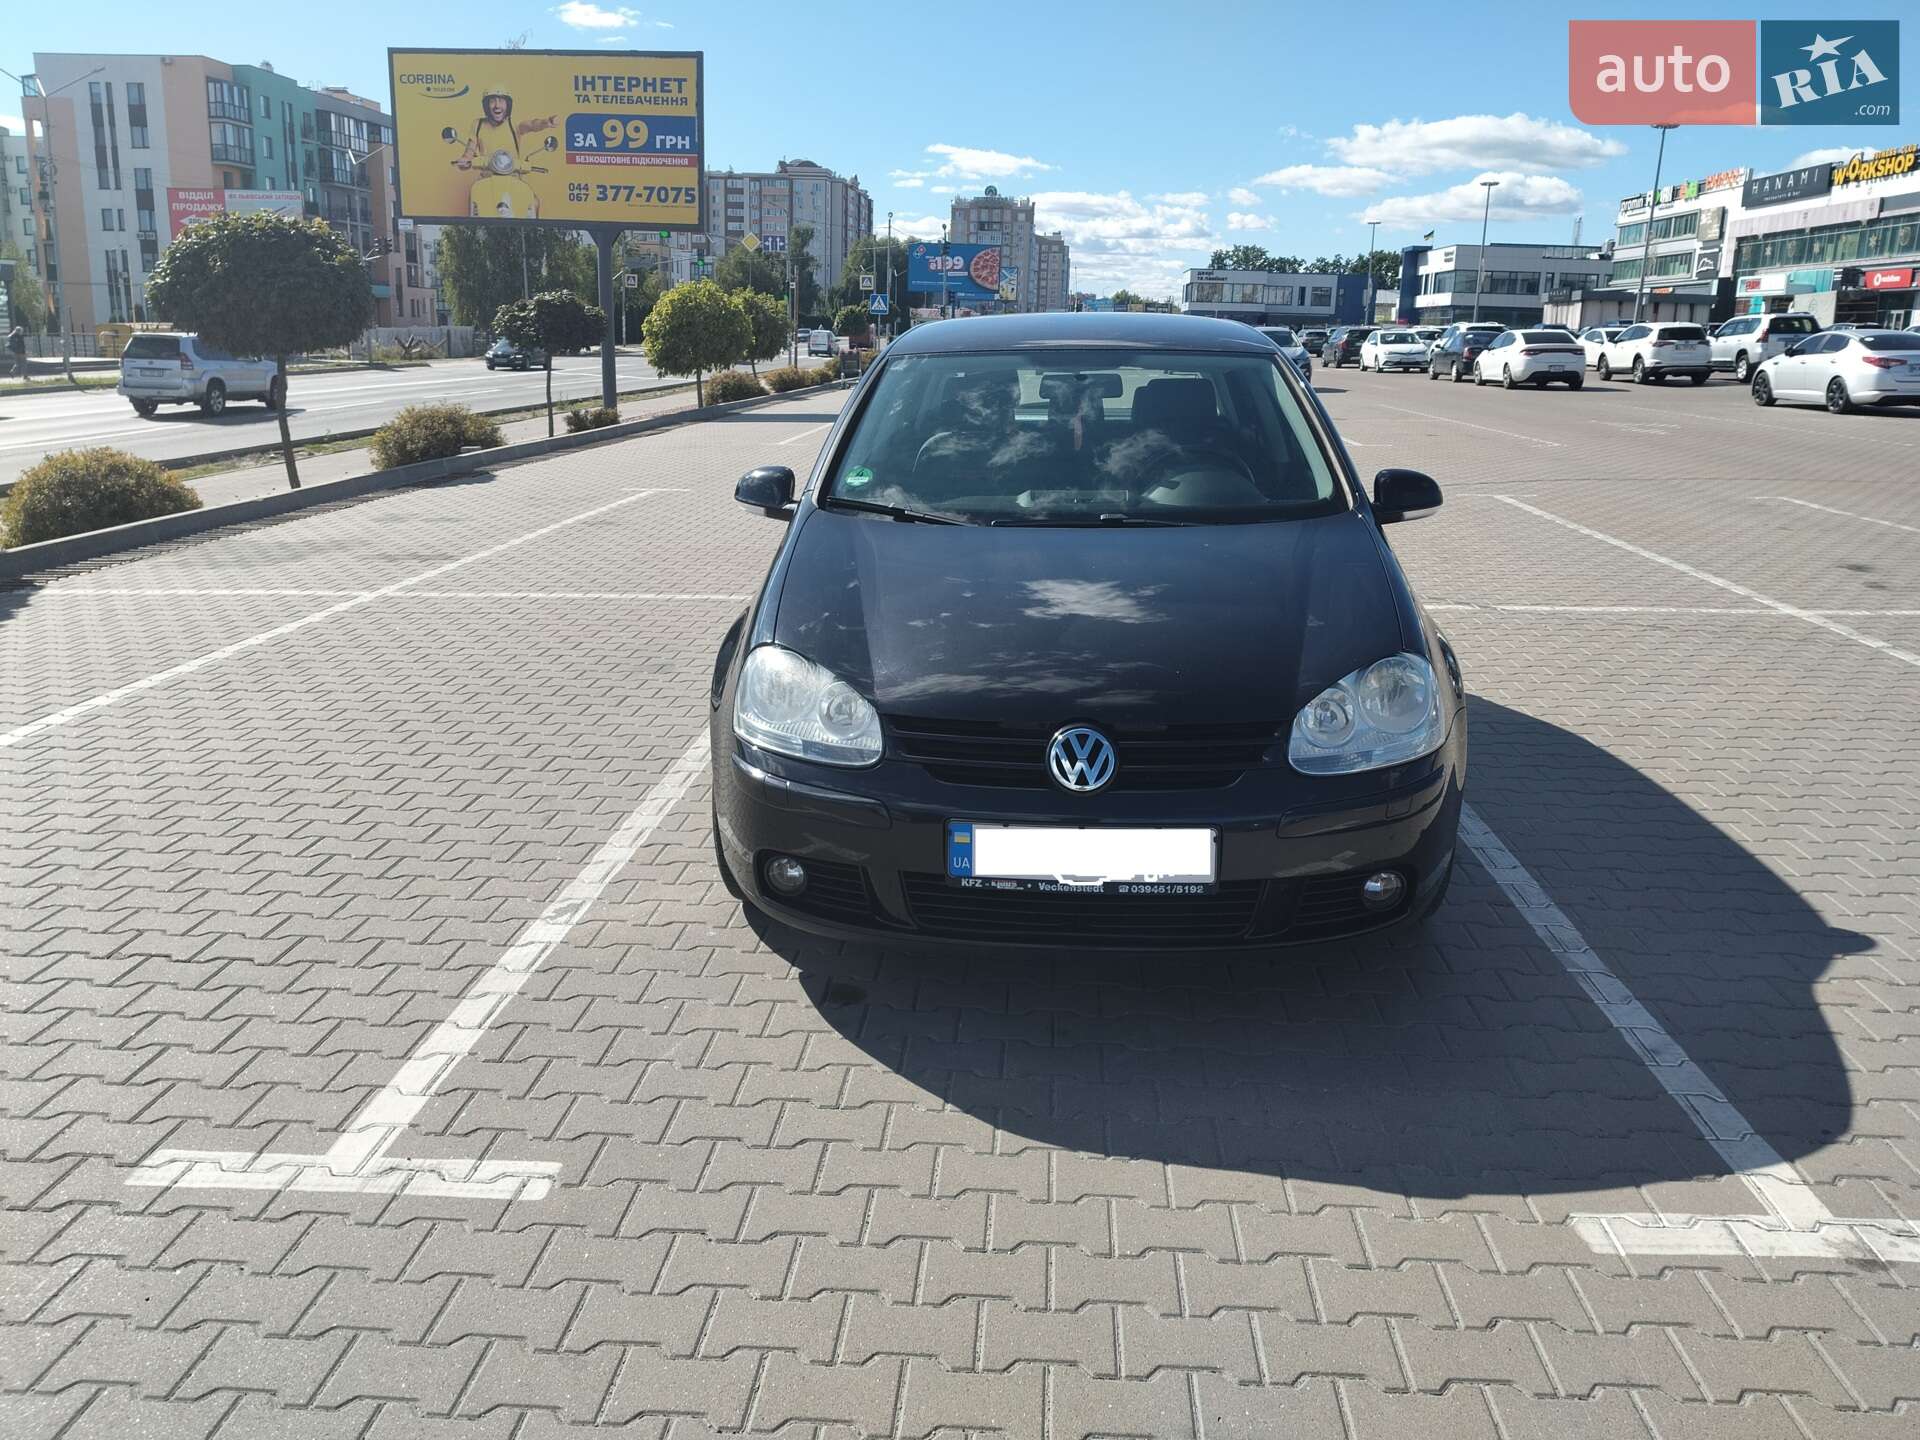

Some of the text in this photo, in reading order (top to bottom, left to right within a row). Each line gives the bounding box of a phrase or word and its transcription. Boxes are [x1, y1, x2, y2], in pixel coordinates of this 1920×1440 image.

[400, 74, 455, 85] CORBINA
[574, 75, 688, 93] ІНТЕРНЕТ
[575, 94, 688, 106] ТА ТЕЛЕБАЧЕННЯ
[574, 118, 690, 149] ЗА 99 ГРН
[568, 182, 589, 192] 044
[1752, 168, 1818, 194] HANAMI
[568, 192, 589, 201] 067
[596, 184, 697, 204] 377-7075
[953, 856, 970, 868] UA
[961, 878, 982, 888] KFZ
